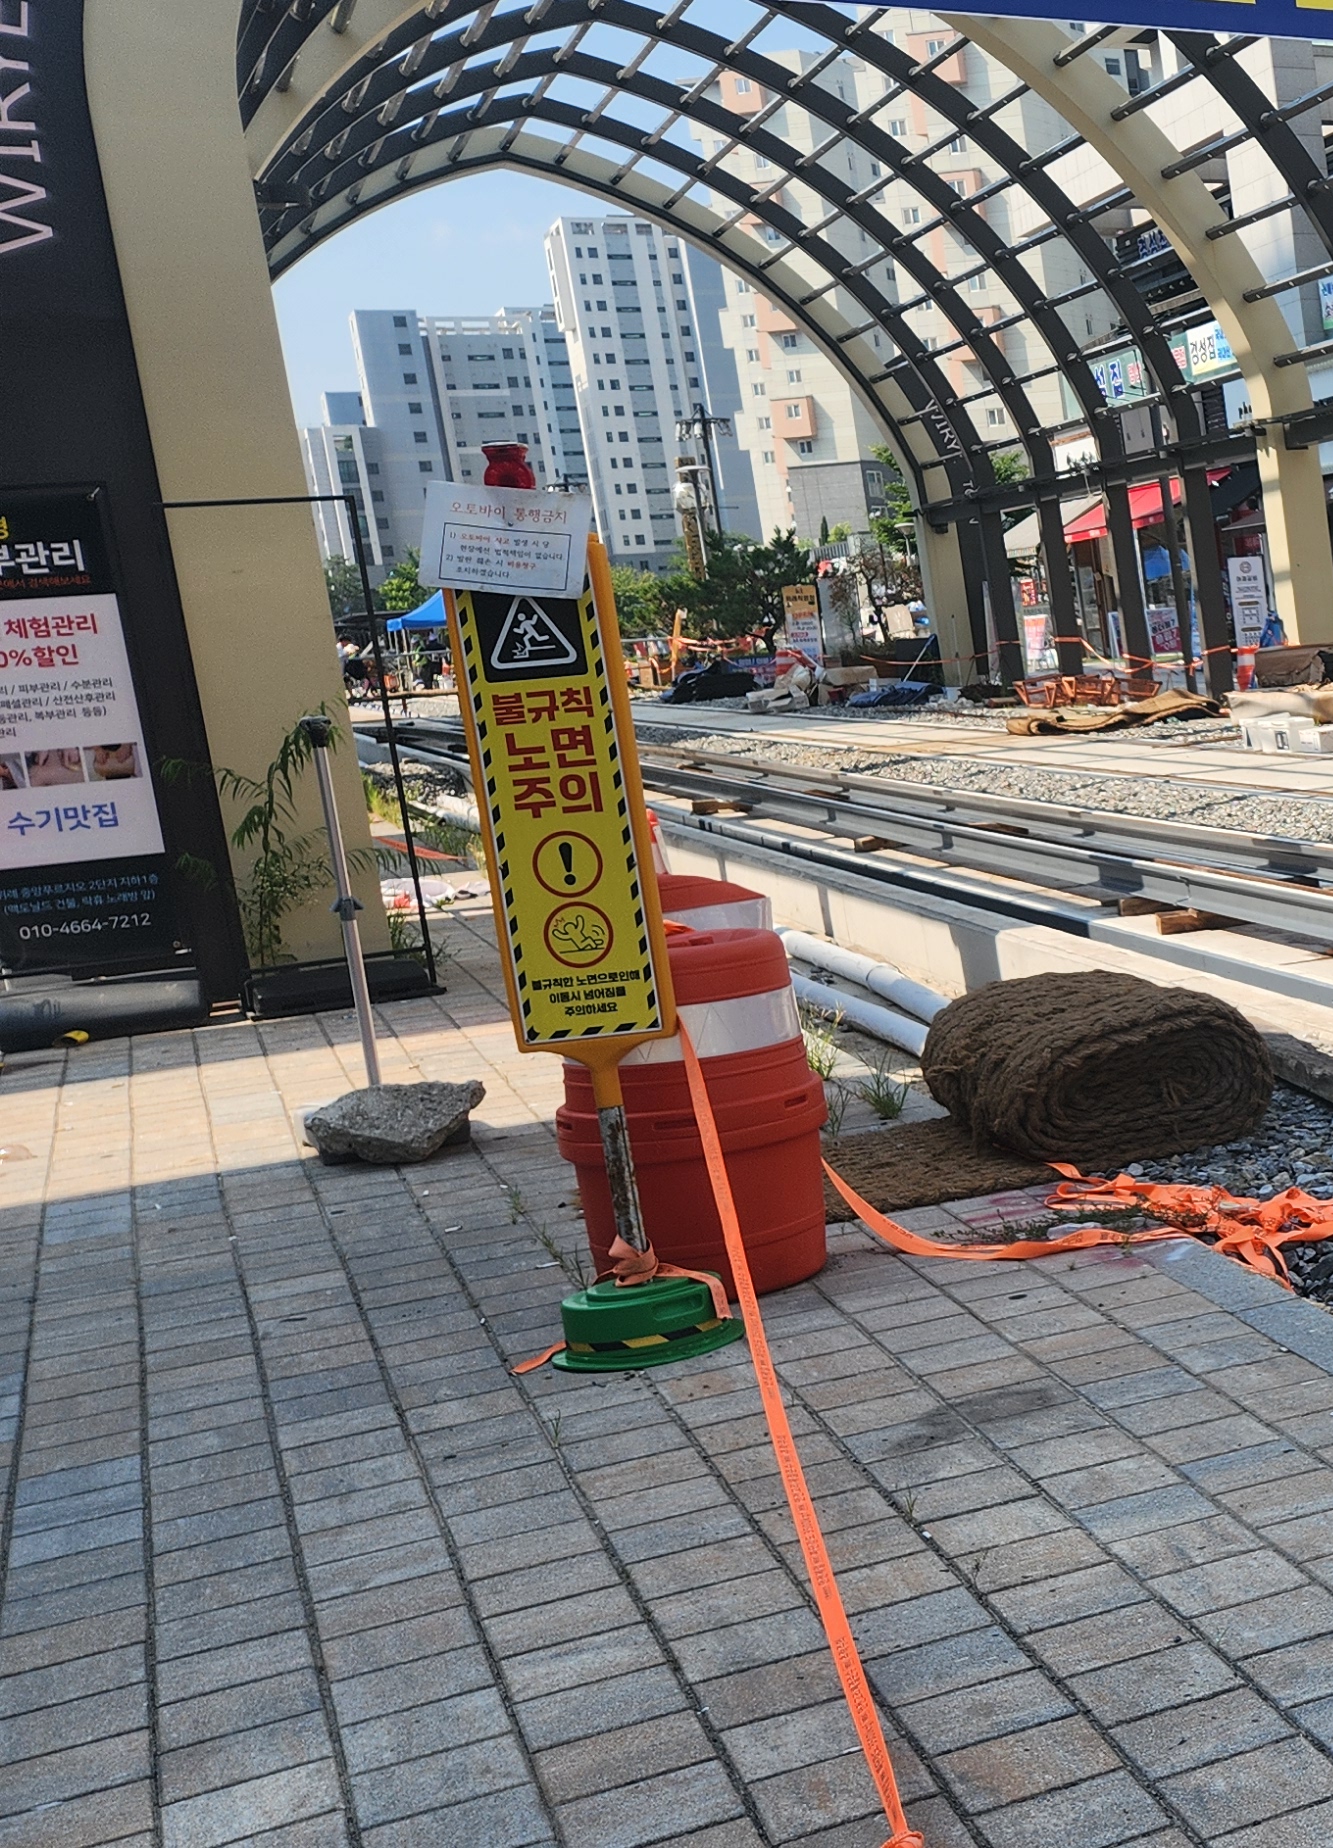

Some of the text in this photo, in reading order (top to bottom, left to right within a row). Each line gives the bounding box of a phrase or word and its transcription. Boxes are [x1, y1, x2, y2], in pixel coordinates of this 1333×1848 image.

[450, 502, 567, 524] 오토바이 통행금지
[4, 612, 98, 639] 체험관리
[70, 676, 113, 690] 수분관리
[491, 685, 595, 727] 불규칙
[504, 724, 598, 773] 노면
[512, 771, 604, 819] 주의
[7, 801, 119, 836] 수기맛집
[19, 912, 152, 941] 010-4664-7212
